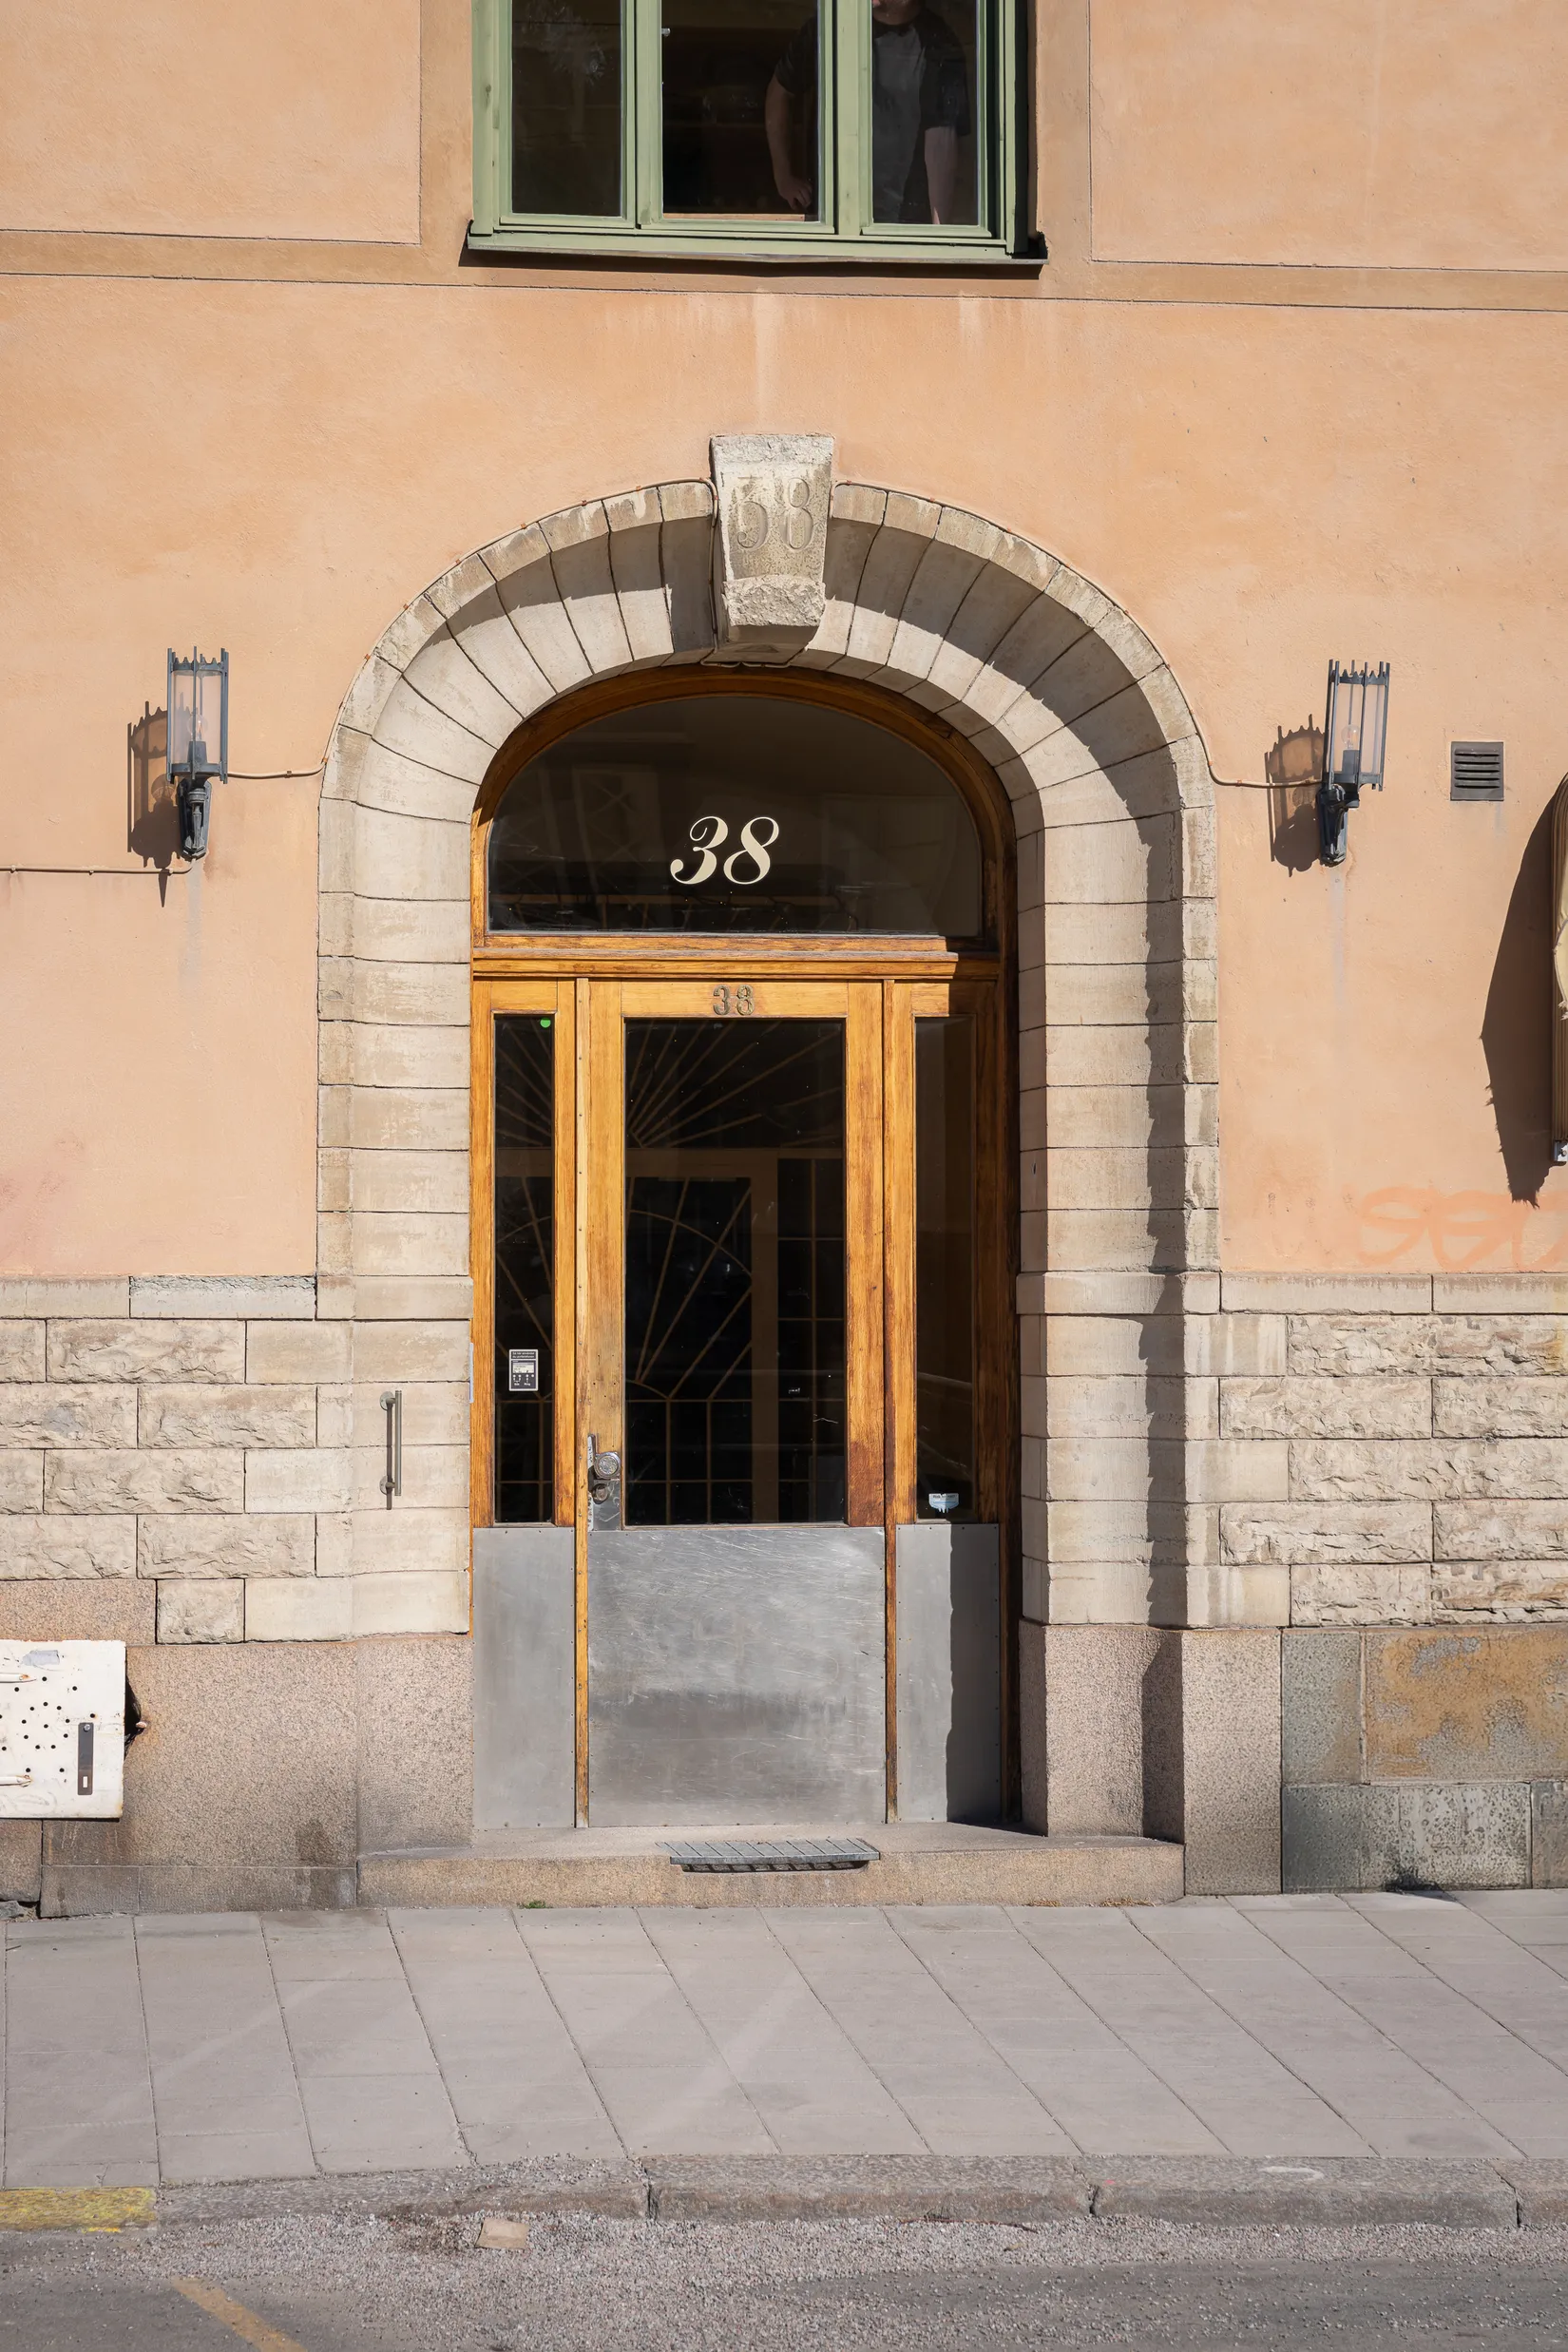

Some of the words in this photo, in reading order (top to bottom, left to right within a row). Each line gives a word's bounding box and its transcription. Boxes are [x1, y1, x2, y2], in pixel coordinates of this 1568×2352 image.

[736, 476, 814, 550] 38
[670, 815, 779, 885] 38
[713, 984, 755, 1016] 38
